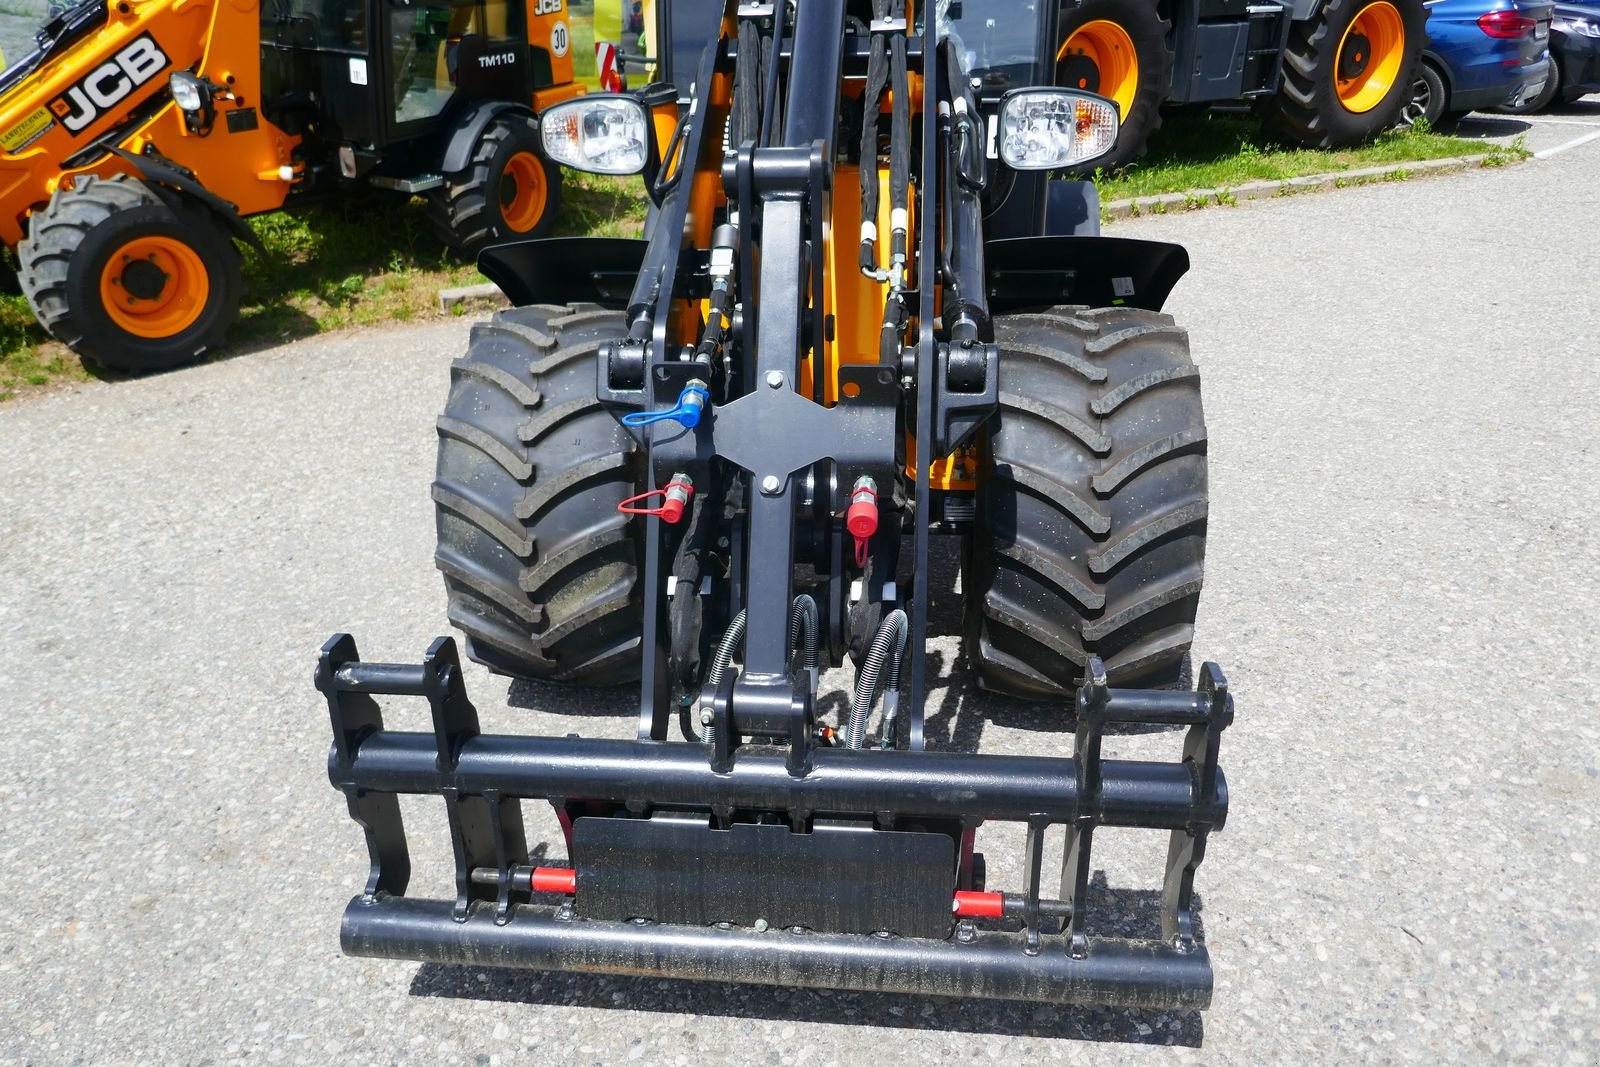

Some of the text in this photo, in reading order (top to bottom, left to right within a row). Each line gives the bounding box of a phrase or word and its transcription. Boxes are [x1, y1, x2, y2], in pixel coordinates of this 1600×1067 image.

[534, 0, 562, 16] JCB
[554, 28, 566, 50] 30
[478, 52, 515, 68] TM110
[63, 36, 167, 131] JCB
